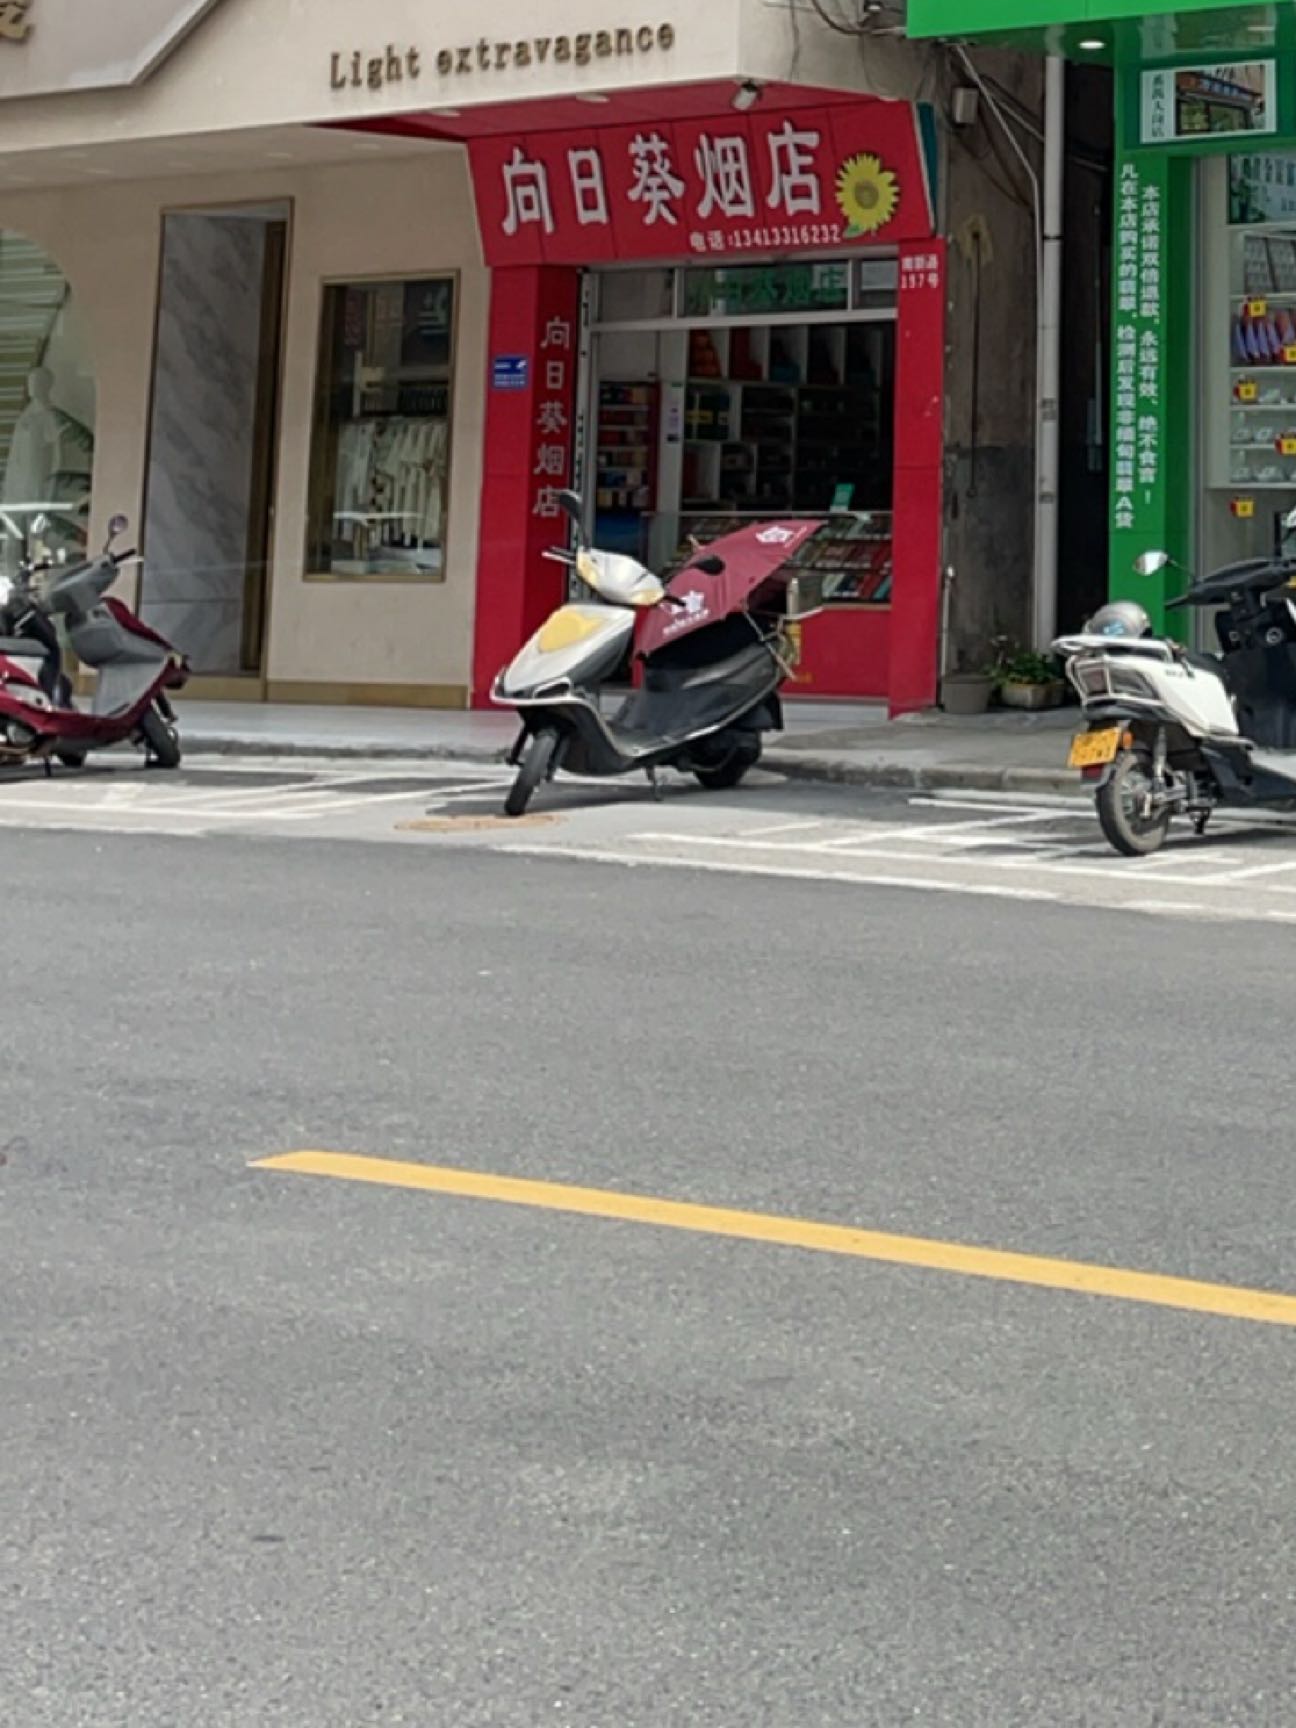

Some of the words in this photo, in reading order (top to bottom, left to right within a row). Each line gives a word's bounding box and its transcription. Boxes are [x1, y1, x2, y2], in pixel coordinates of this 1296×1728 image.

[330, 45, 420, 89] Light
[436, 23, 676, 78] extravagance
[501, 120, 821, 237] 向日葵烟店
[533, 316, 571, 518] 向日葵烟店
